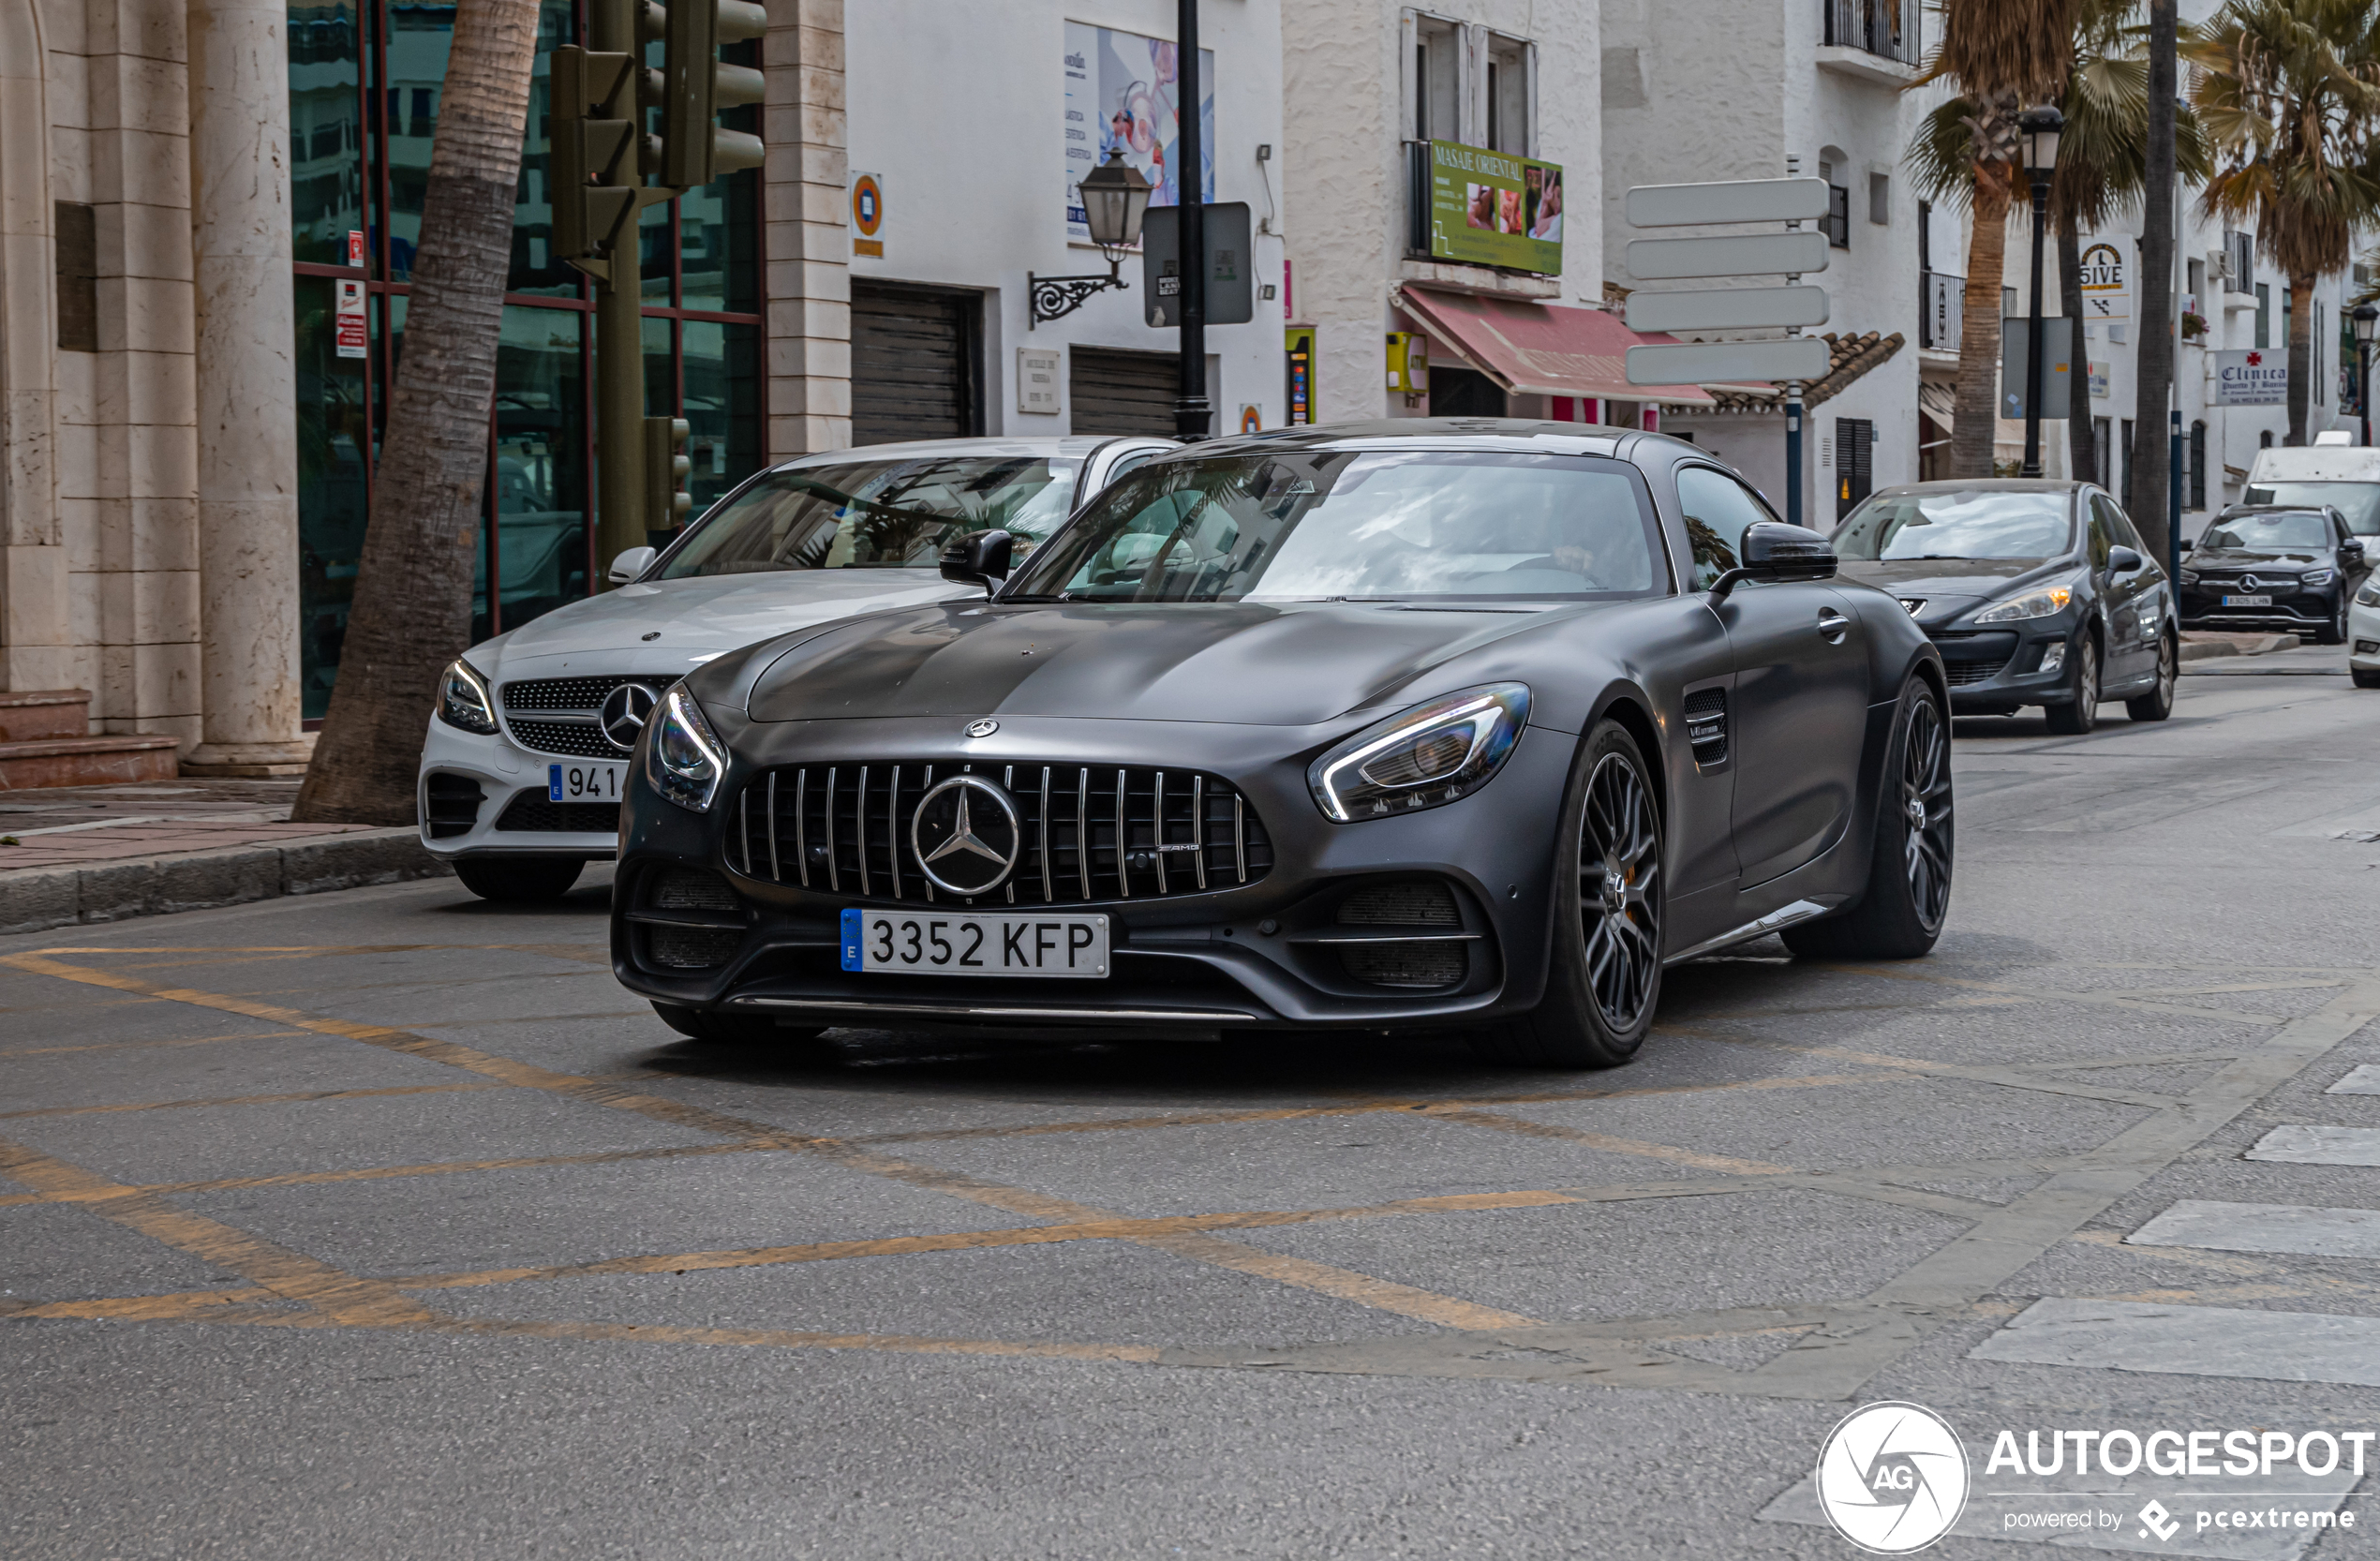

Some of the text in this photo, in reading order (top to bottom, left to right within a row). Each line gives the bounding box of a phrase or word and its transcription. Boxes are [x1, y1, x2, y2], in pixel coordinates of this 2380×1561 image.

[1435, 145, 1522, 181] MASAJE ORIENTAL
[569, 767, 626, 796] 941
[847, 919, 1093, 968] E 3352 KFP
